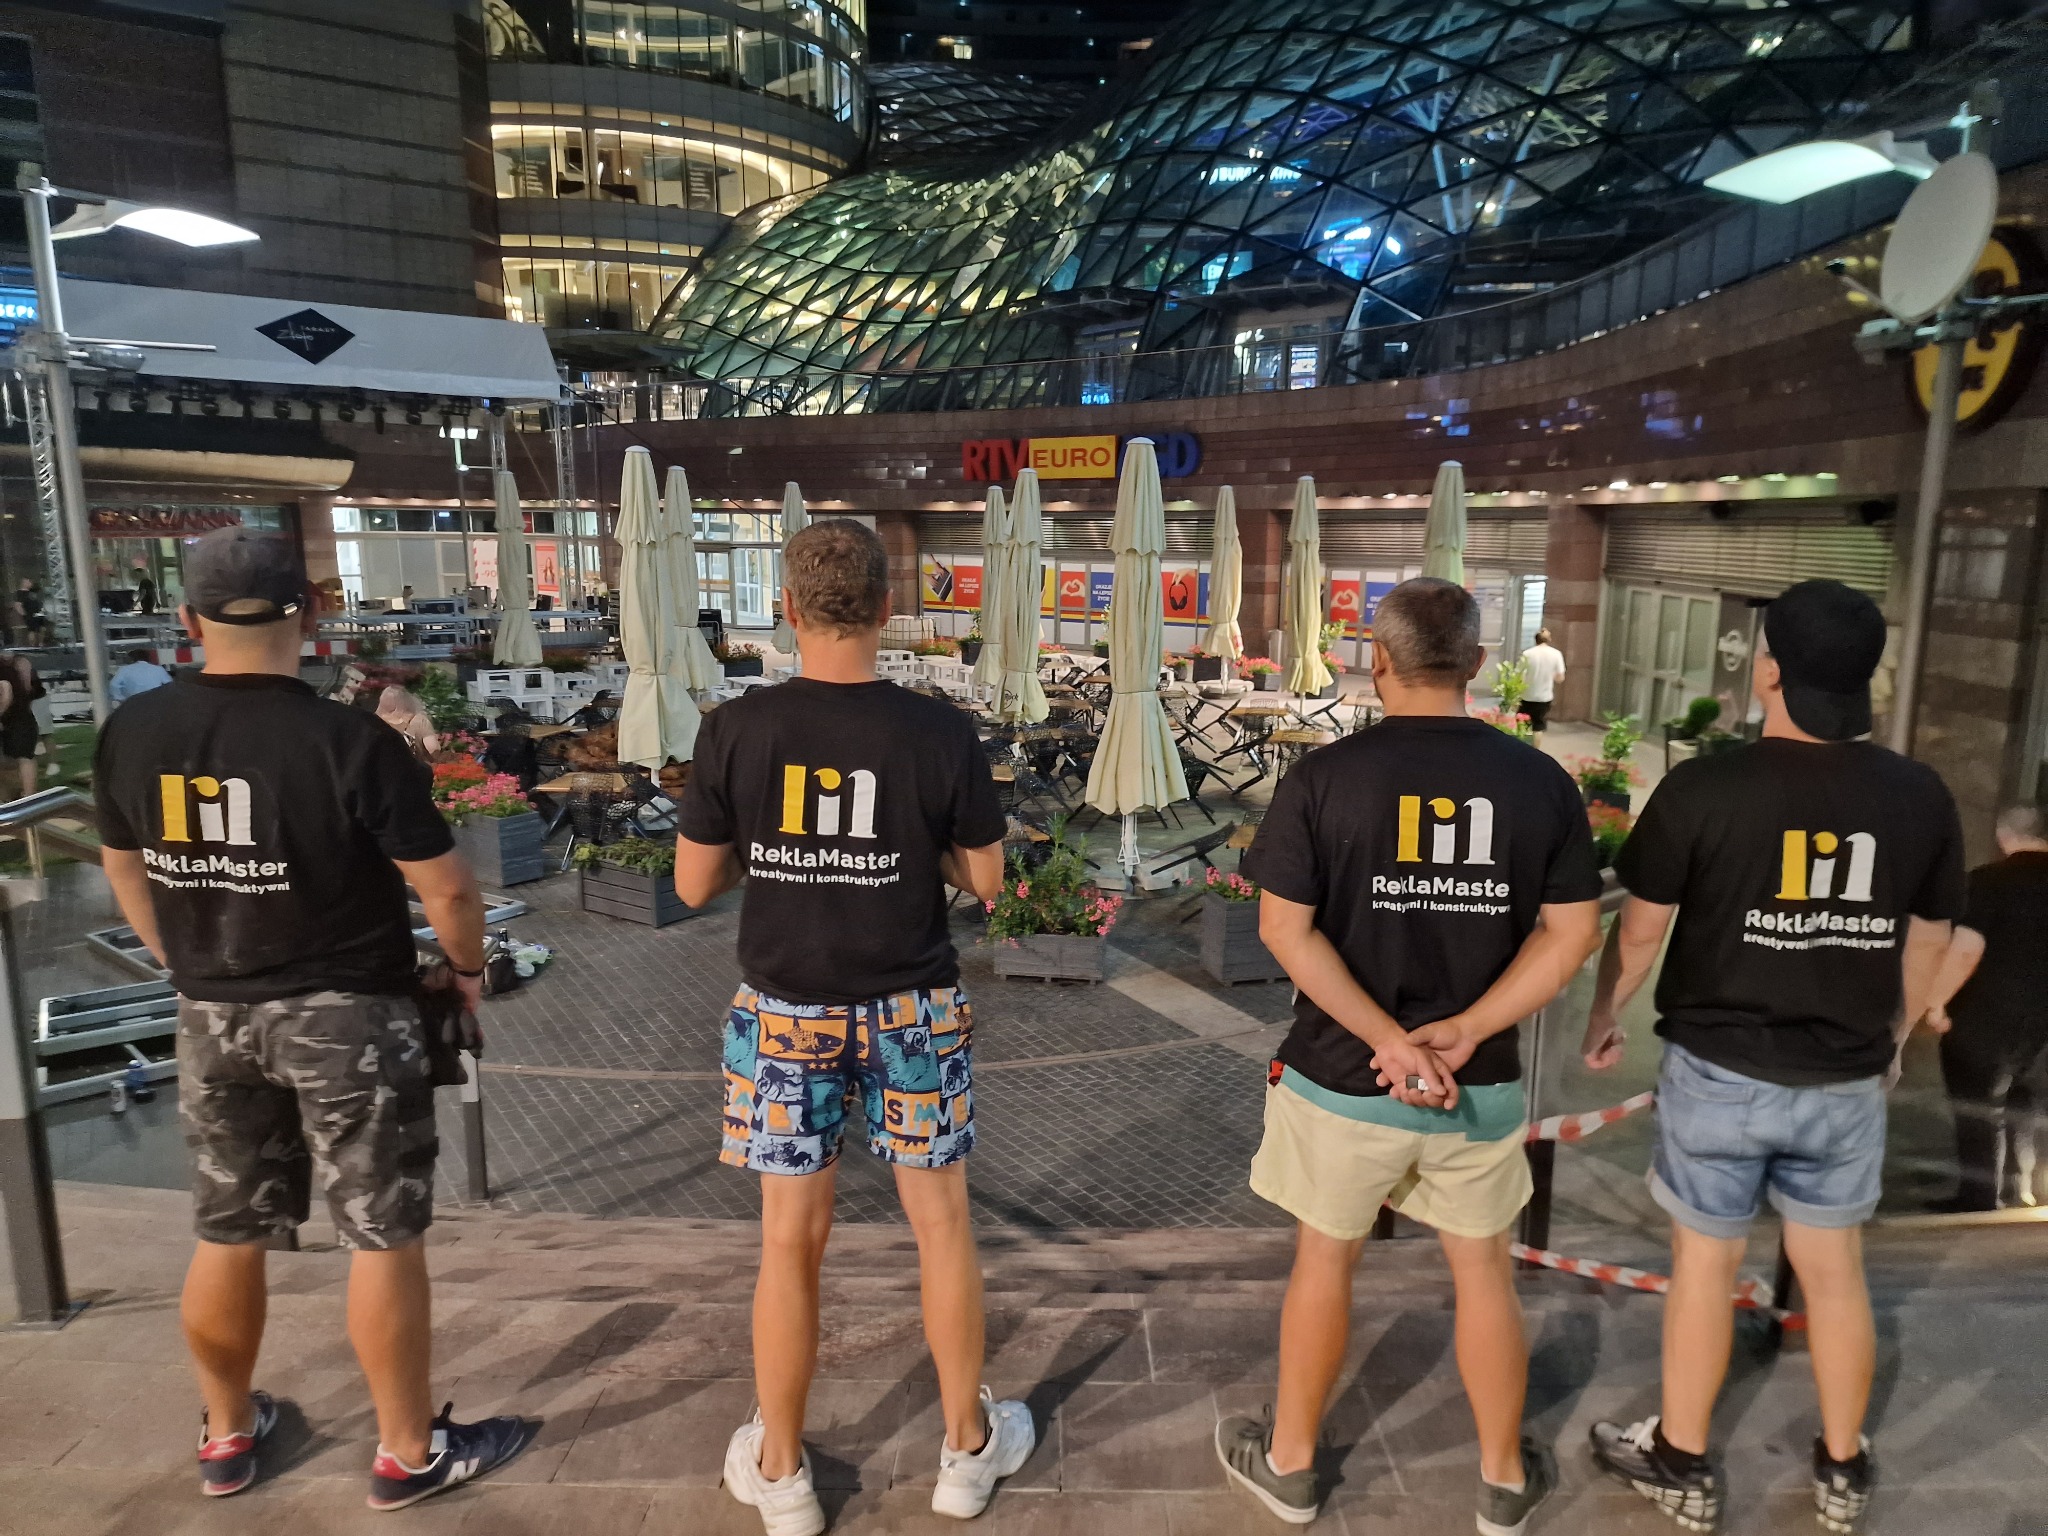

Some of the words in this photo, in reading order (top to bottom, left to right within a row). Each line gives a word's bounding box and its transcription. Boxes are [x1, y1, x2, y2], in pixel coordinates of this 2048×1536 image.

[963, 438, 1029, 480] RTV
[1033, 446, 1111, 469] EURO
[750, 841, 901, 870] ReklaMaster
[750, 866, 807, 884] kreatywni
[817, 872, 900, 888] konstruktywni
[1372, 874, 1510, 898] ReklaMaste
